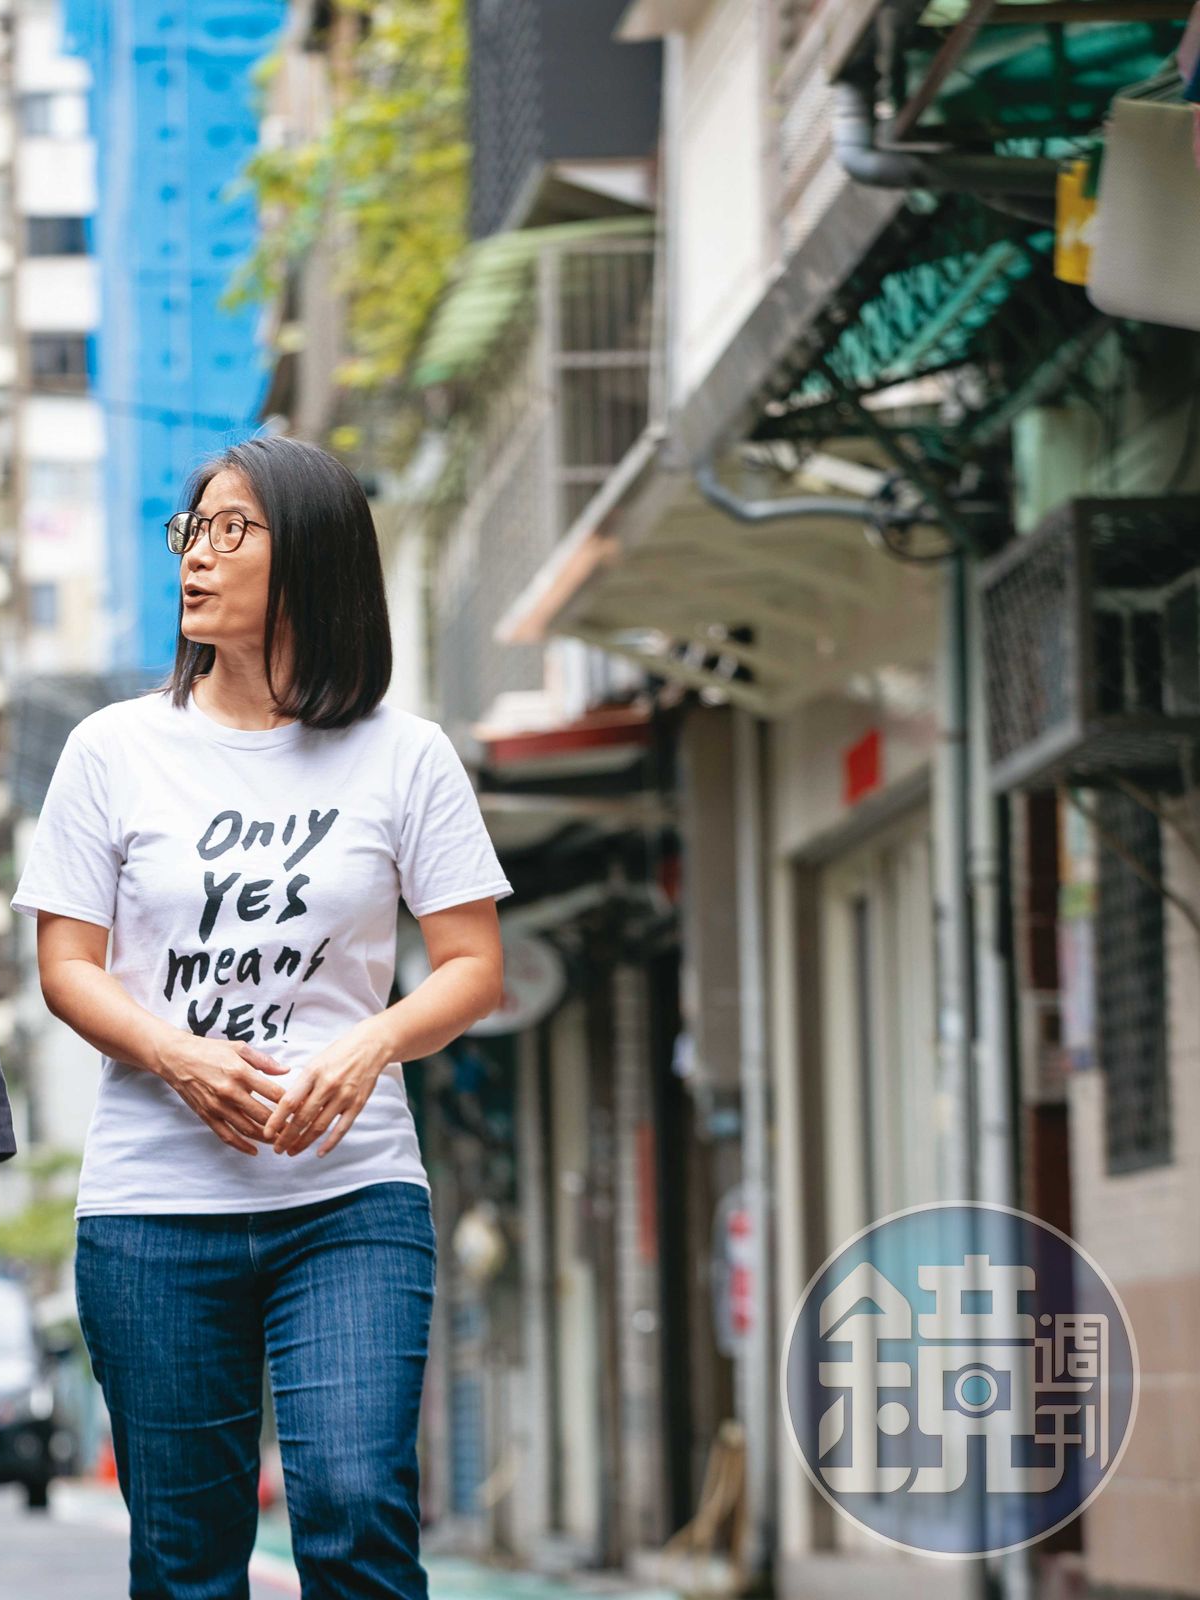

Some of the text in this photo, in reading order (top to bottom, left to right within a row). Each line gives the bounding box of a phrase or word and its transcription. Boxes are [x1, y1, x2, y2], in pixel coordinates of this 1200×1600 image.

[196, 808, 340, 872] Only
[198, 871, 311, 944] YES
[163, 937, 331, 1002] means
[187, 997, 295, 1043] YES!
